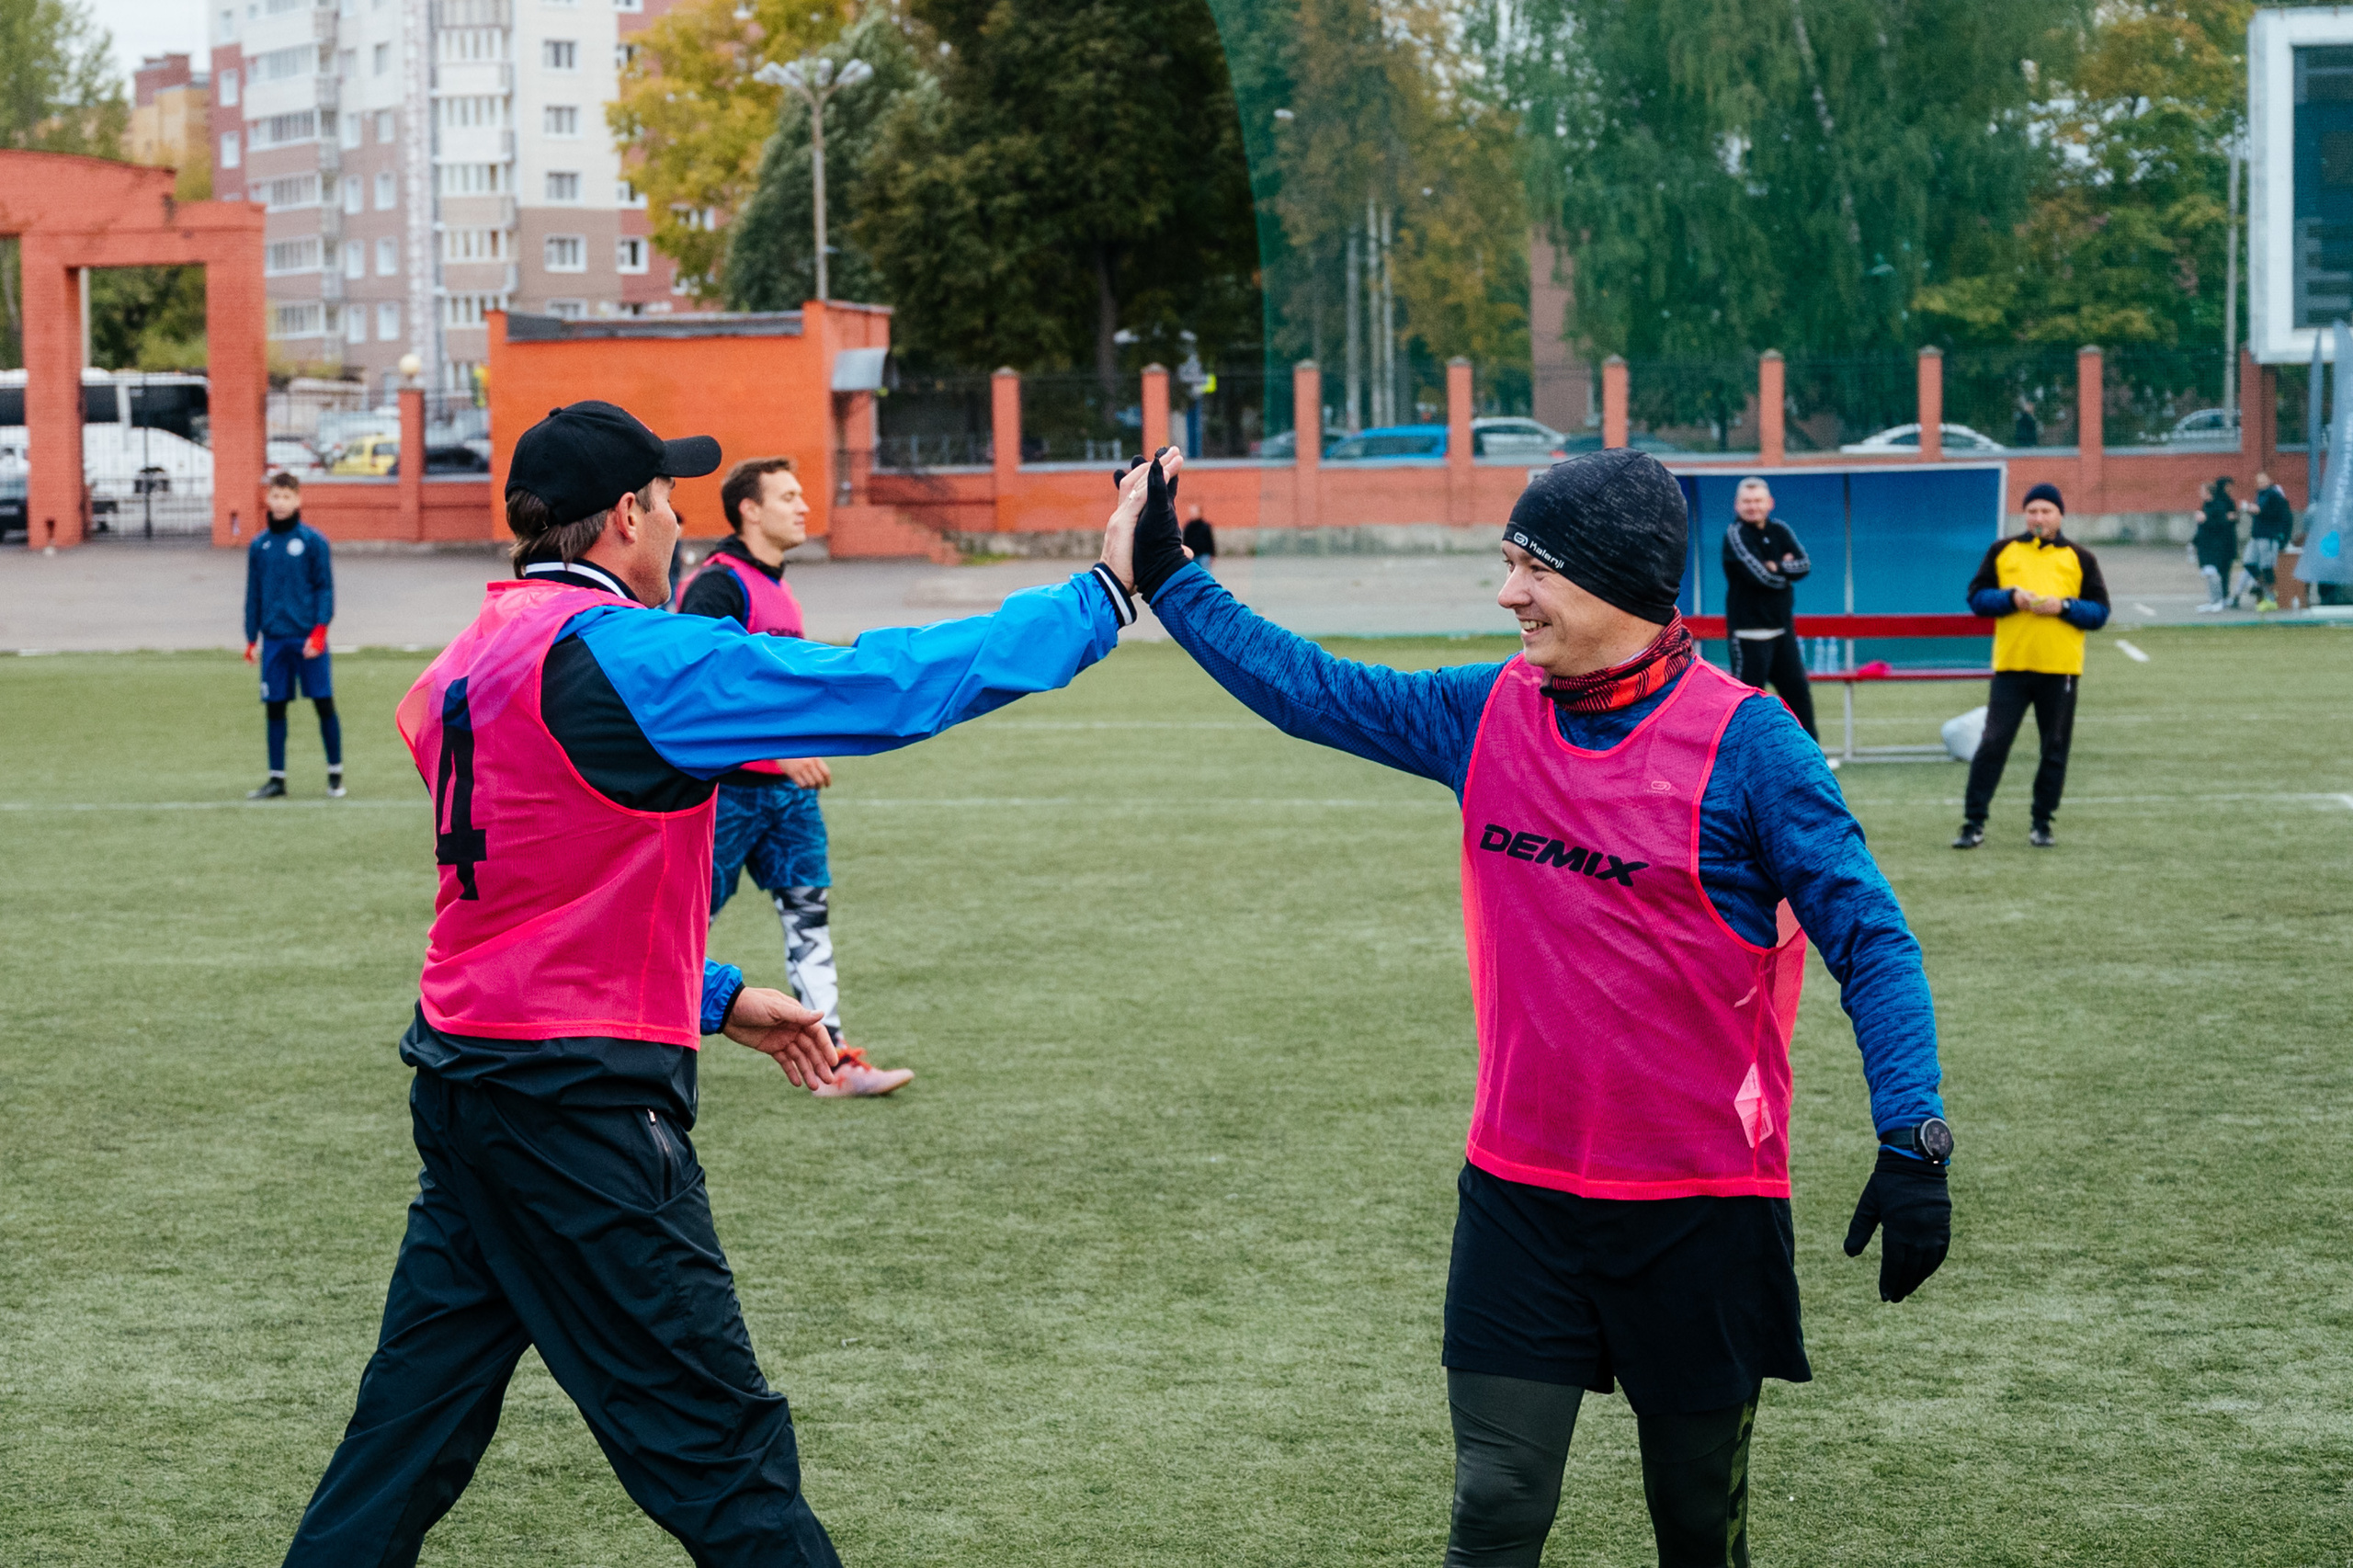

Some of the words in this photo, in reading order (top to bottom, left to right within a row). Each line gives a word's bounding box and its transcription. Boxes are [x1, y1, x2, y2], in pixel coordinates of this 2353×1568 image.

[1529, 540, 1565, 569] Kalenji
[435, 675, 487, 901] 4
[1480, 824, 1650, 887] DEMIX
